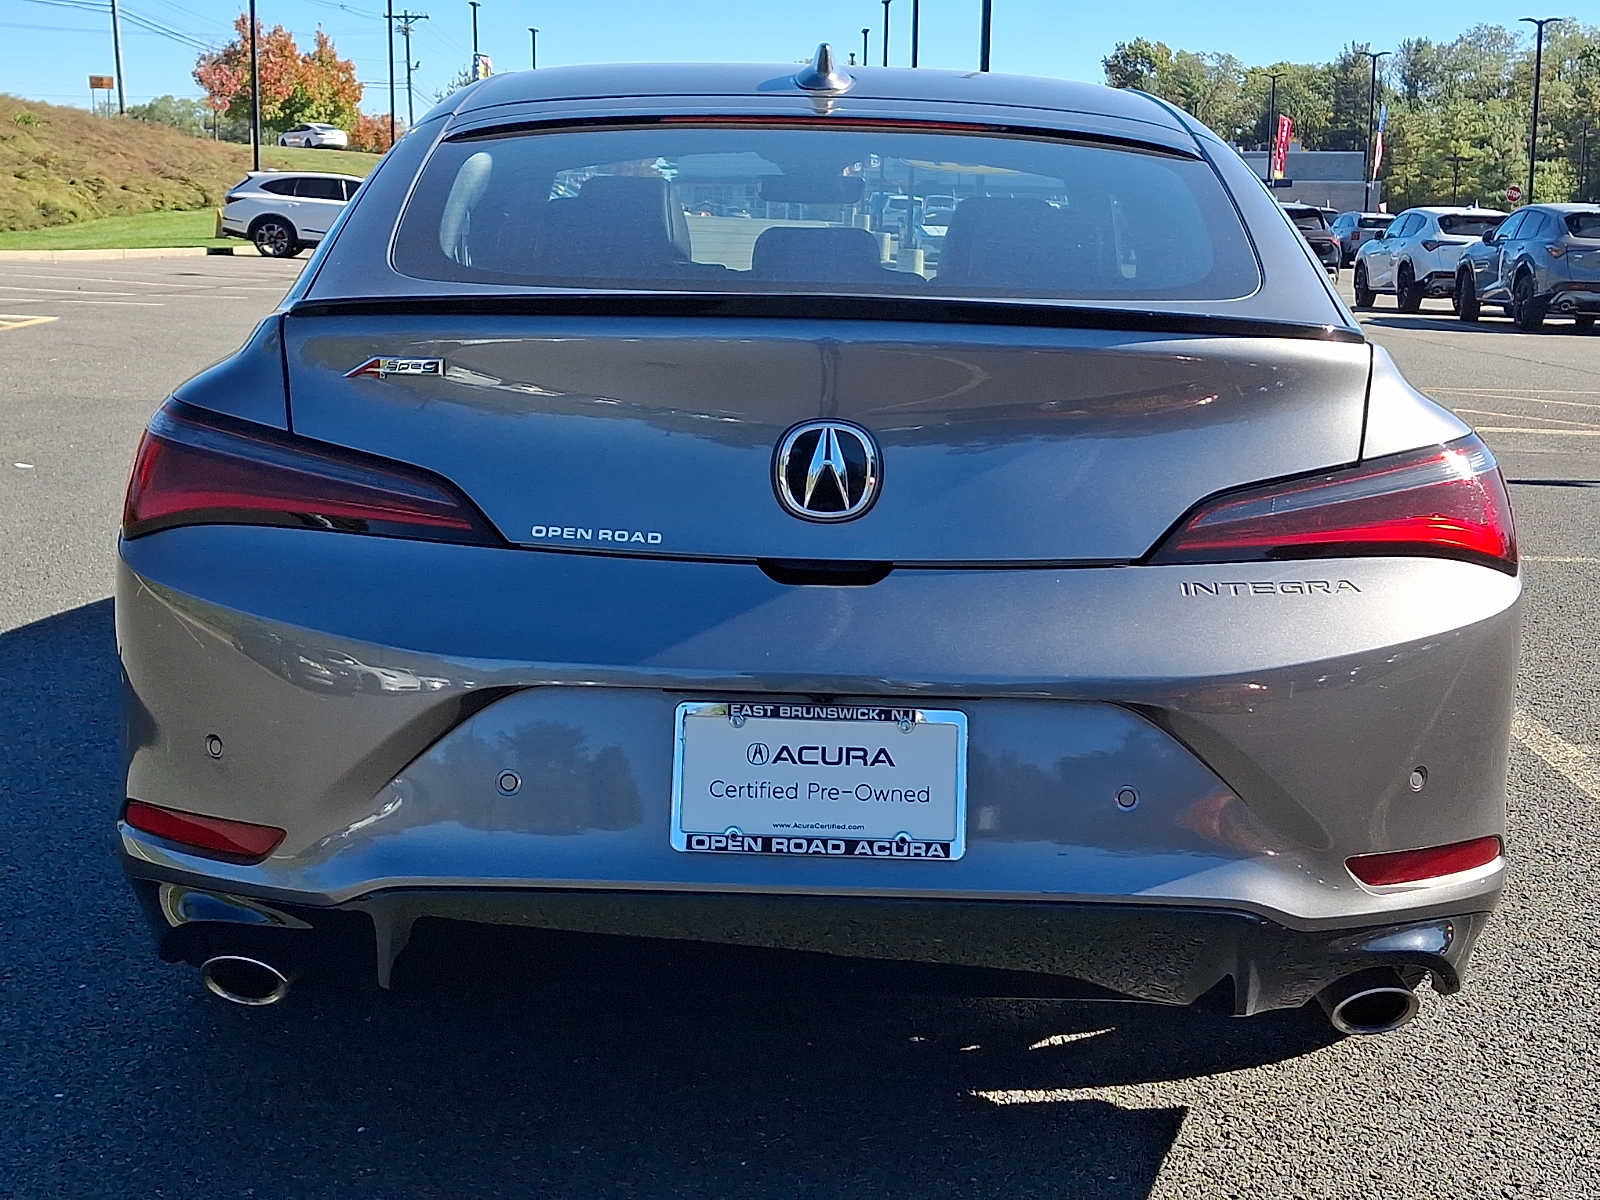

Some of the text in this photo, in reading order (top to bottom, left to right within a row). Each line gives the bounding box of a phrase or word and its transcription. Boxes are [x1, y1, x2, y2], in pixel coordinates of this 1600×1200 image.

[531, 525, 662, 544] OPEN ROAD
[1180, 579, 1362, 597] INTEGRA
[730, 704, 913, 721] EAST BRUNSWICK, NJ
[772, 745, 896, 767] ACURA
[709, 779, 930, 803] Certified Pre-Owned
[772, 821, 865, 831] www.AcuraCertified.com
[691, 835, 946, 858] OPEN ROAD ACURA
